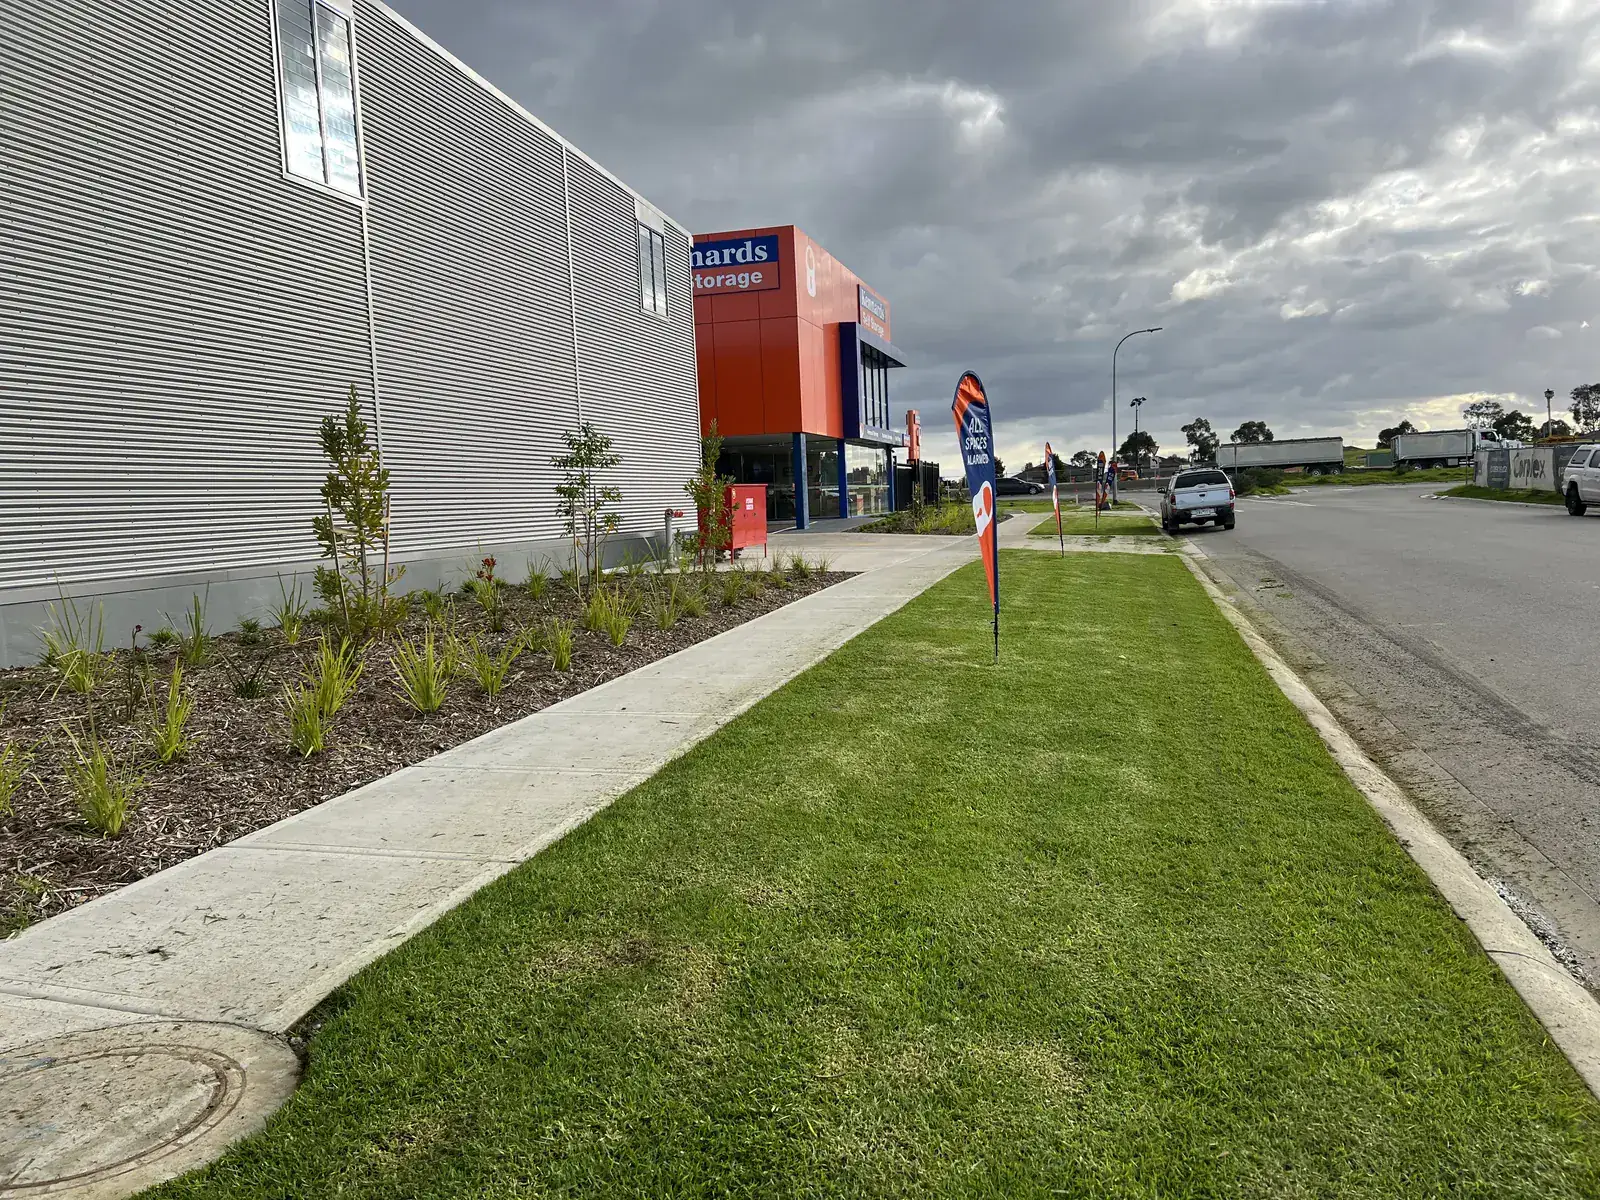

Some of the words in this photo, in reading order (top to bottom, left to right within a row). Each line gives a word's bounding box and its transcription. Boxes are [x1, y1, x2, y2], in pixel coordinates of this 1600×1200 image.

[692, 271, 763, 288] torage
[968, 417, 983, 433] ALL
[965, 437, 987, 450] SPACES
